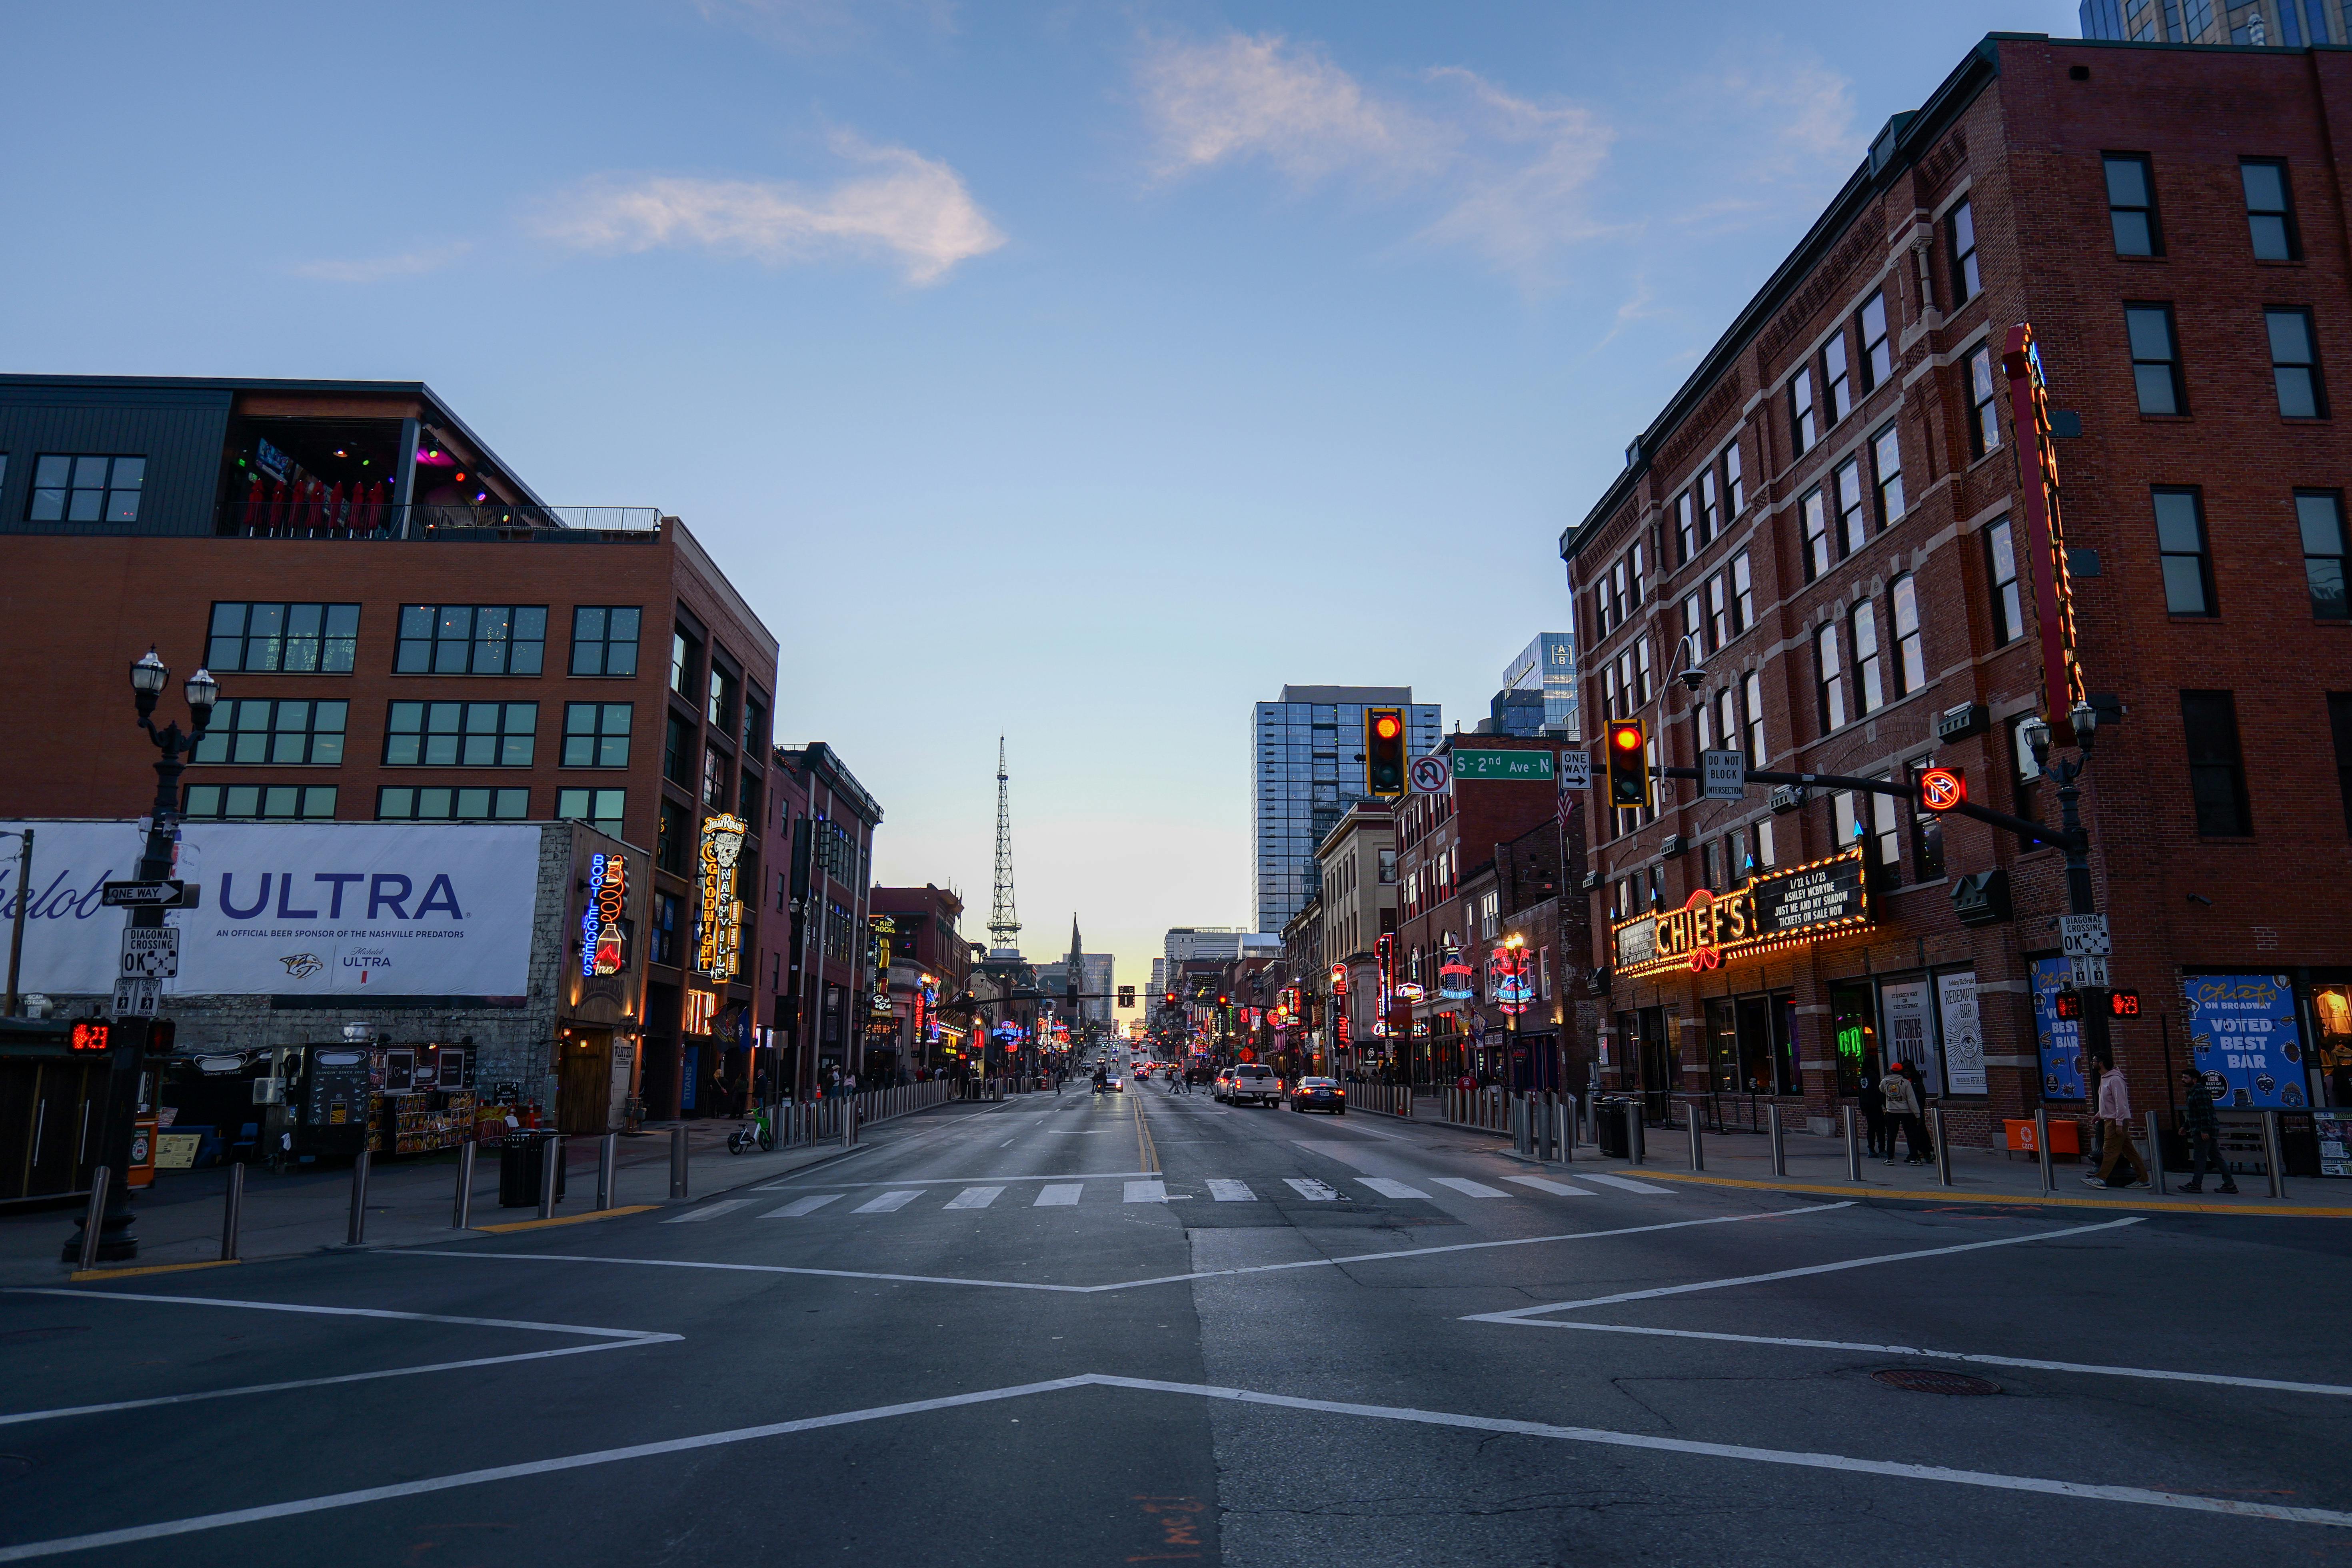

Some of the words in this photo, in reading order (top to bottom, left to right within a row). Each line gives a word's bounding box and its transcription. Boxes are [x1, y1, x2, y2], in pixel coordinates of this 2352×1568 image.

[1565, 753, 1586, 763] ONE
[1709, 756, 1719, 765] DO
[1725, 756, 1739, 765] NOT
[1565, 765, 1587, 773] WAY
[1711, 769, 1737, 779] BLOCK
[1790, 877, 1804, 889] 1/22
[1805, 876, 1810, 885] &
[1812, 871, 1826, 884] 1/23
[112, 888, 134, 899] ONE
[137, 888, 160, 898] WAY
[220, 873, 464, 919] ULTRA
[1784, 889, 1806, 903] ASHLEY
[1808, 881, 1834, 897] MCBRYDE
[1774, 905, 1788, 917] JUST
[1790, 903, 1798, 913] ME
[1800, 899, 1811, 911] AND
[1813, 897, 1821, 908] MY
[1824, 891, 1848, 906] SHADOW
[583, 855, 604, 977] BOOTLEGGERS
[701, 863, 718, 969] GOODNIGHT
[1778, 913, 1802, 927] TICKETS
[1803, 911, 1811, 922] ON
[1813, 908, 1828, 920] SALE
[1829, 905, 1843, 917] NOW
[2066, 915, 2102, 925] DIAGONAL
[714, 869, 732, 979] NASHVILLE
[1656, 896, 1746, 955] CHIEF'S
[2067, 923, 2102, 933] CROSSING
[131, 930, 174, 939] DIAGONAL
[131, 940, 172, 949] CROSSING
[2064, 935, 2083, 950] OK
[350, 947, 384, 956] Michelob
[124, 953, 146, 971] OK
[343, 957, 391, 967] ULTRA
[1948, 979, 1959, 987] Ashley
[1959, 977, 1975, 986] McBryde
[1443, 990, 1472, 999] RIVIERA
[1498, 989, 1531, 999] RIVIRA
[1960, 1003, 1972, 1018] BAR
[1894, 1018, 1922, 1039] OUTSIDERS
[2210, 1018, 2272, 1032] VOTED
[2055, 1036, 2078, 1048] BAR
[2219, 1036, 2267, 1050] BEST
[615, 1046, 632, 1058] WANTED
[1896, 1039, 1924, 1064] RADIO
[2227, 1054, 2266, 1068] BAR
[683, 1067, 692, 1101] TITANS
